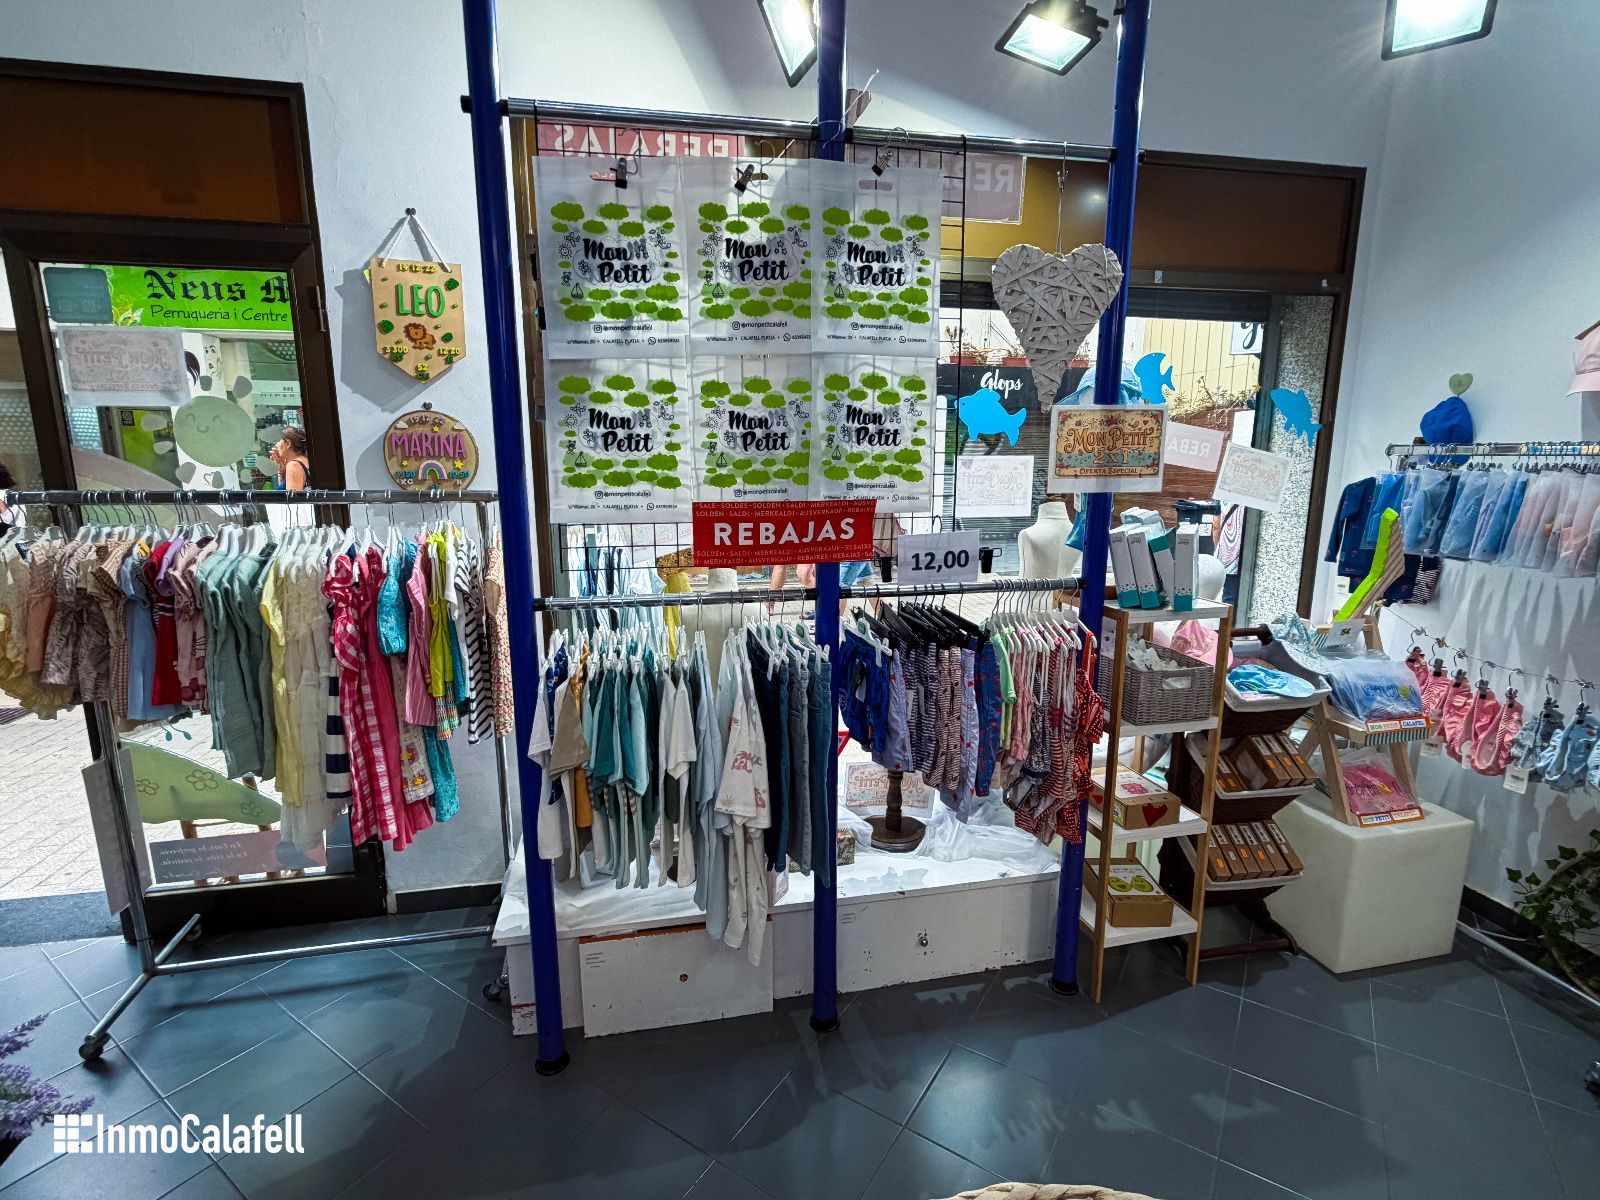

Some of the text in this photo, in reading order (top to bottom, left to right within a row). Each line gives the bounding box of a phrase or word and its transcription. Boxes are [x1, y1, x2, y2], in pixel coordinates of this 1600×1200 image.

[582, 238, 632, 261] Mon
[725, 238, 771, 259] Mon
[847, 242, 890, 264] Mon
[597, 261, 652, 284] Petit
[738, 260, 789, 282] Petit
[858, 265, 906, 286] Petit
[144, 270, 246, 300] Neus
[397, 282, 445, 317] LEO
[151, 304, 288, 321] Perruqueria i Centre
[980, 369, 1024, 399] Glops
[588, 408, 635, 430] Mon
[728, 410, 773, 430] Mon
[846, 404, 886, 425] Mon
[391, 432, 466, 459] MARINA
[601, 430, 654, 452] Petit
[741, 431, 790, 452] Petit
[854, 426, 901, 446] Petit
[714, 518, 854, 546] REBAJAS
[911, 550, 970, 573] 12,00
